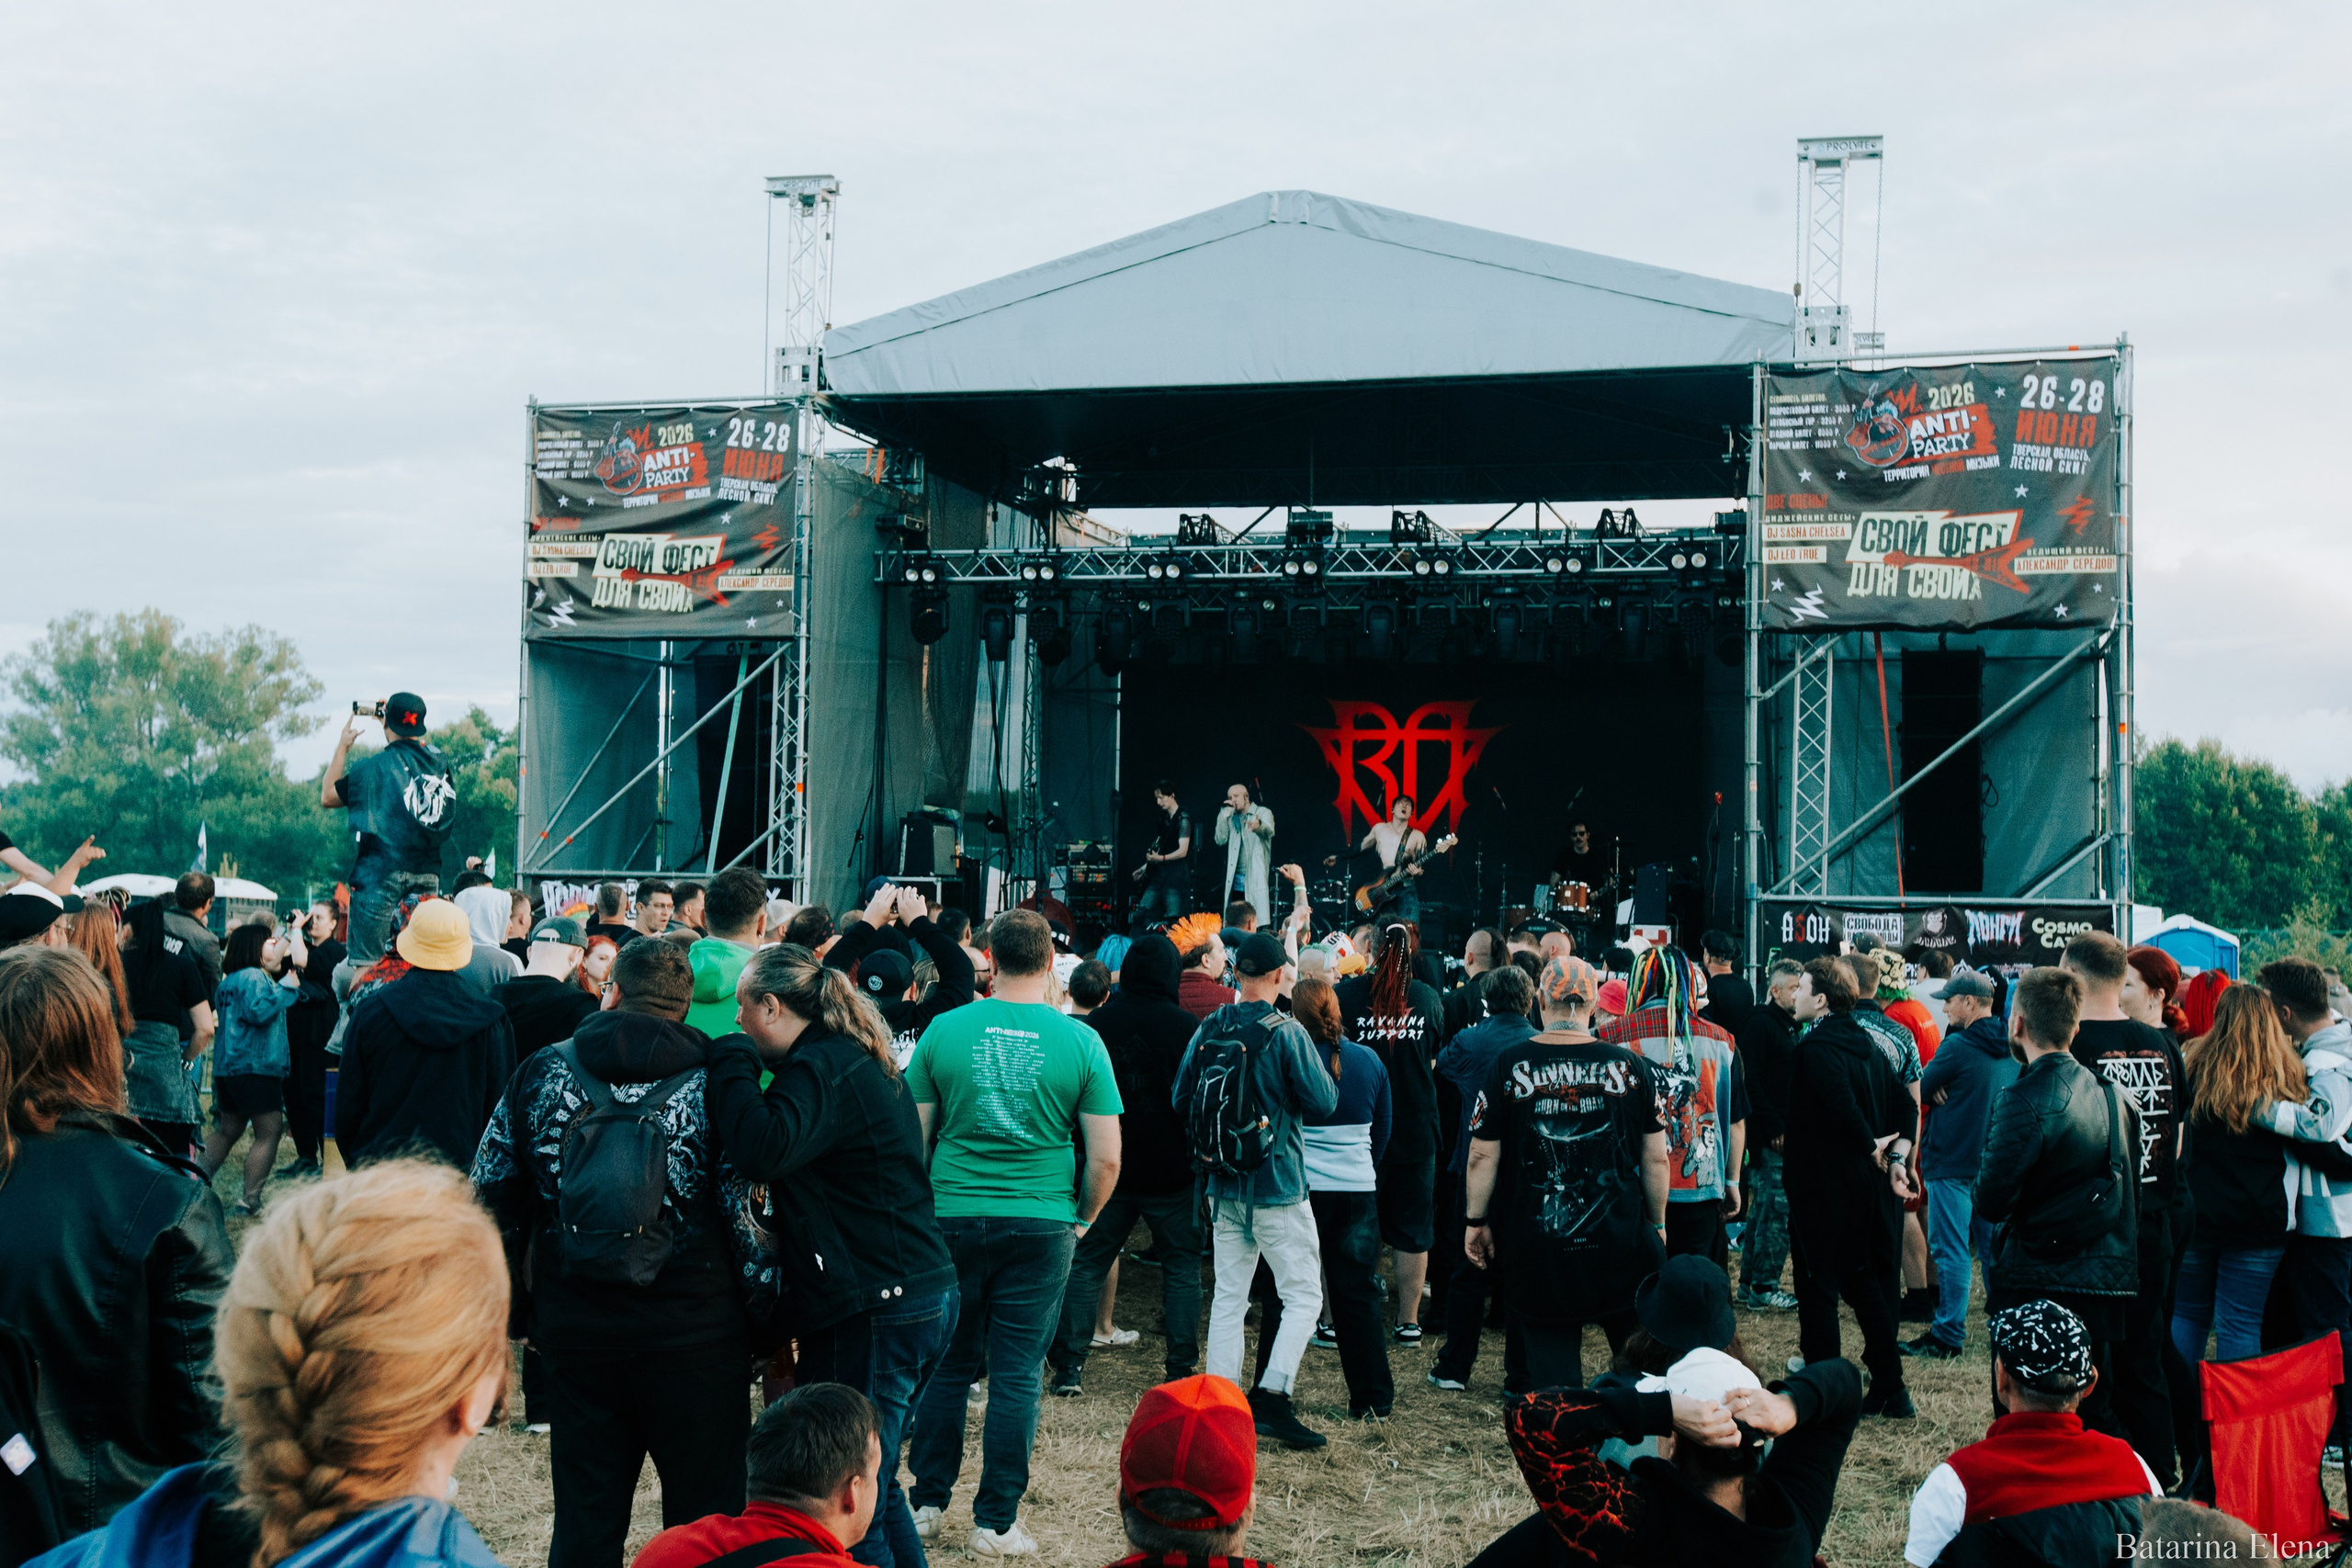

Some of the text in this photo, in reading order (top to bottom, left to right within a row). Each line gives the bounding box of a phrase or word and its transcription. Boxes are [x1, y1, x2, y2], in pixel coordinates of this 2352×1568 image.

[1826, 140, 1869, 152] PROLYTE
[1928, 380, 1975, 412] 2026
[2019, 374, 2105, 414] 26-28
[658, 422, 694, 447] 2026
[727, 417, 791, 453] 26-28
[1909, 409, 1978, 441] ANTI-
[2015, 409, 2098, 448] ИЮНЯ
[1911, 432, 1971, 459] PARTY
[2012, 443, 2052, 458] ТВЕРСКАЯ
[644, 446, 695, 473] ANTI-
[722, 447, 785, 482] ИЮНЯ
[1883, 465, 1930, 482] ТЕРРИТОРИЯ
[1965, 455, 2000, 472] МУЗЫКИ
[2009, 455, 2053, 472] ЛЕСНОЙ
[644, 466, 690, 489] PARTY
[717, 487, 751, 502] ЛЕСНОЙ
[1767, 525, 1846, 539] DJ SASHA CHELSEA
[1860, 514, 2008, 558] СВОЙ ФЕСТ
[603, 537, 715, 575] СВОЙ ФЕСТ
[1768, 548, 1779, 561] DJ
[1799, 547, 1819, 560] TRUE
[2017, 558, 2069, 571] АЛЕКСАНДР
[719, 577, 760, 589] АЛЕКСАНДР
[1847, 561, 1900, 598] ДЛЯ
[592, 577, 633, 608] ДЛЯ
[1847, 918, 1898, 931] СВОБОДА
[2031, 917, 2093, 936] COSMO
[1356, 1014, 1425, 1029] RAVANNA
[1024, 1031, 1040, 1040] 2026
[1357, 1029, 1424, 1043] SUPPORT
